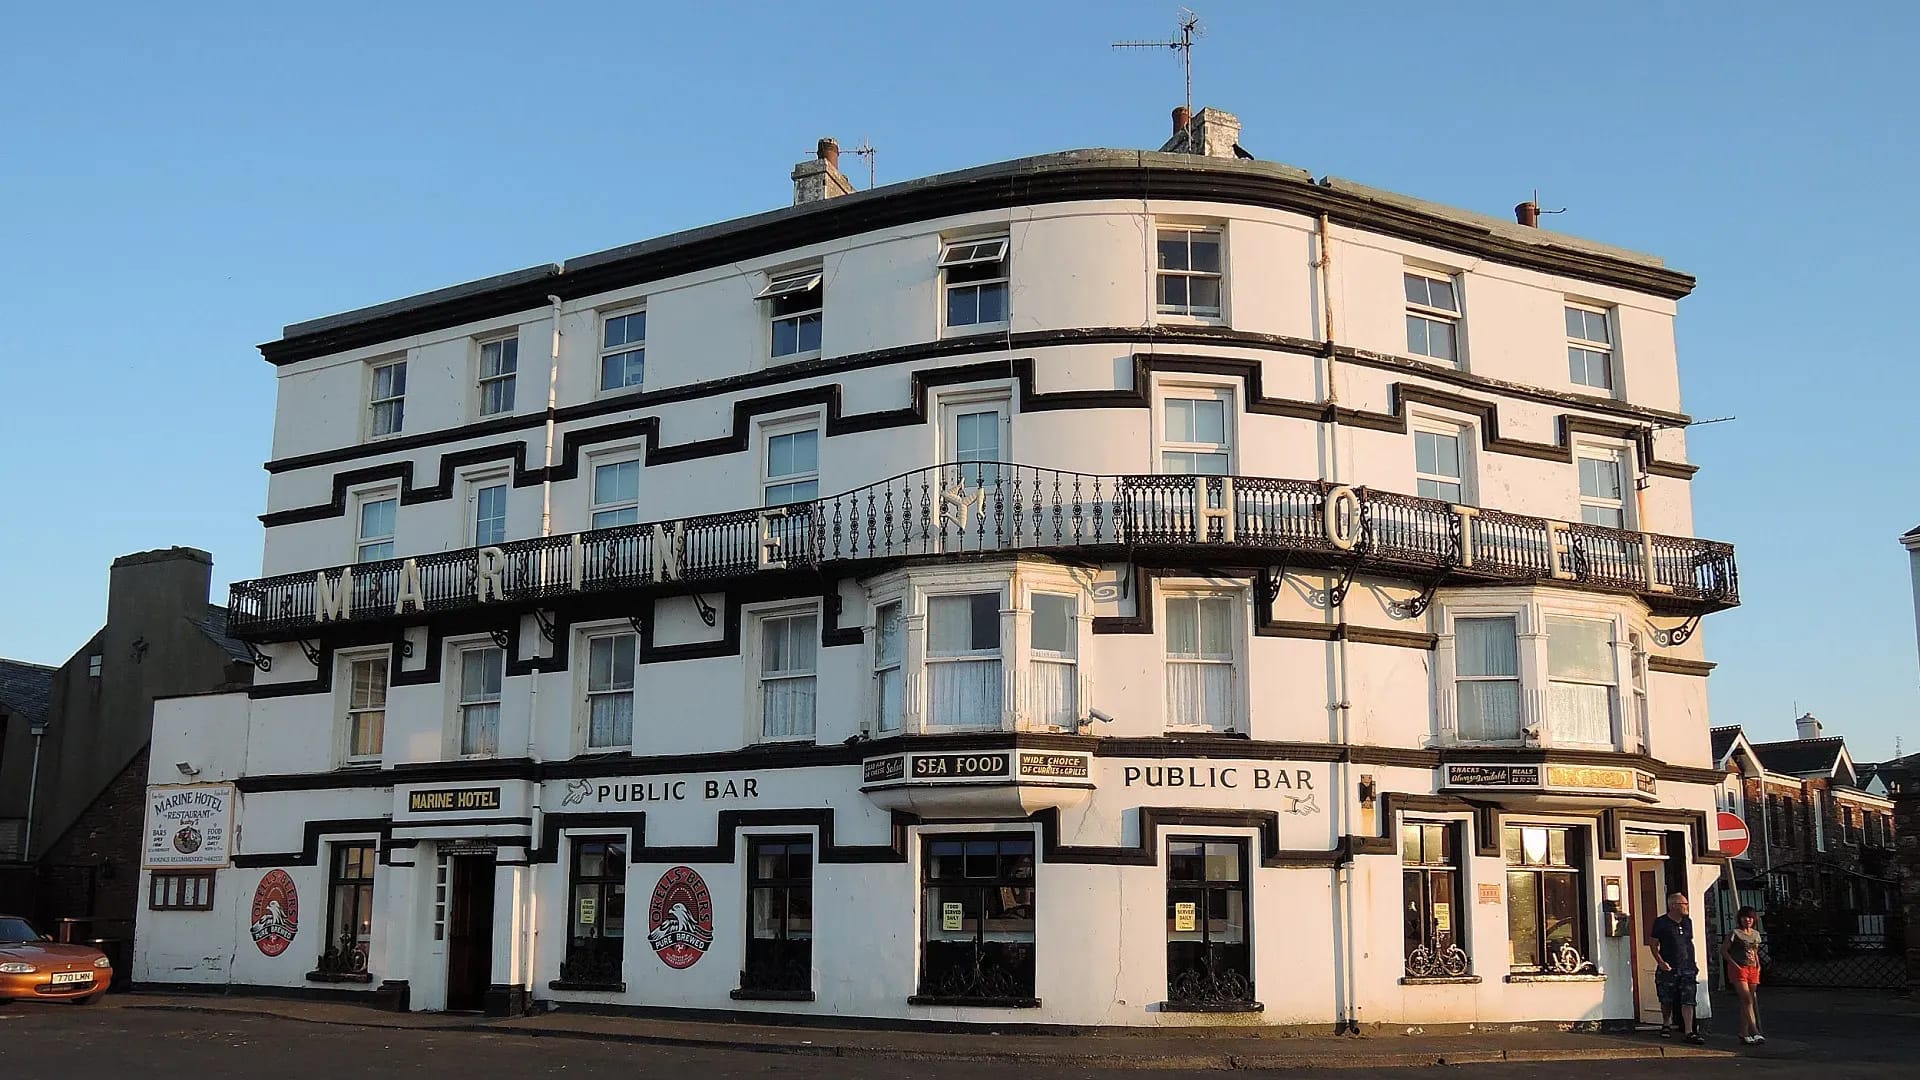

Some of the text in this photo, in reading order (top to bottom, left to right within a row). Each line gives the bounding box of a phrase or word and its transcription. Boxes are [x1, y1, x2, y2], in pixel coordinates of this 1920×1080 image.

[316, 476, 1673, 623] MARINE HOTEL
[917, 757, 1003, 774] SEA FOOD
[1023, 756, 1081, 766] WIDE CHOICE
[1124, 766, 1315, 790] PUBLIC BAR
[412, 789, 498, 809] MARINE HOTEL
[597, 778, 760, 803] PUBLIC BAR
[154, 791, 222, 816] MARINE HOTEL
[167, 809, 210, 820] RESTAURANT
[652, 868, 681, 922] OKELLS
[686, 871, 710, 922] BEERS
[255, 926, 292, 940] PURE BREWED
[655, 933, 705, 950] PURE BREWED
[57, 974, 73, 982] 770
